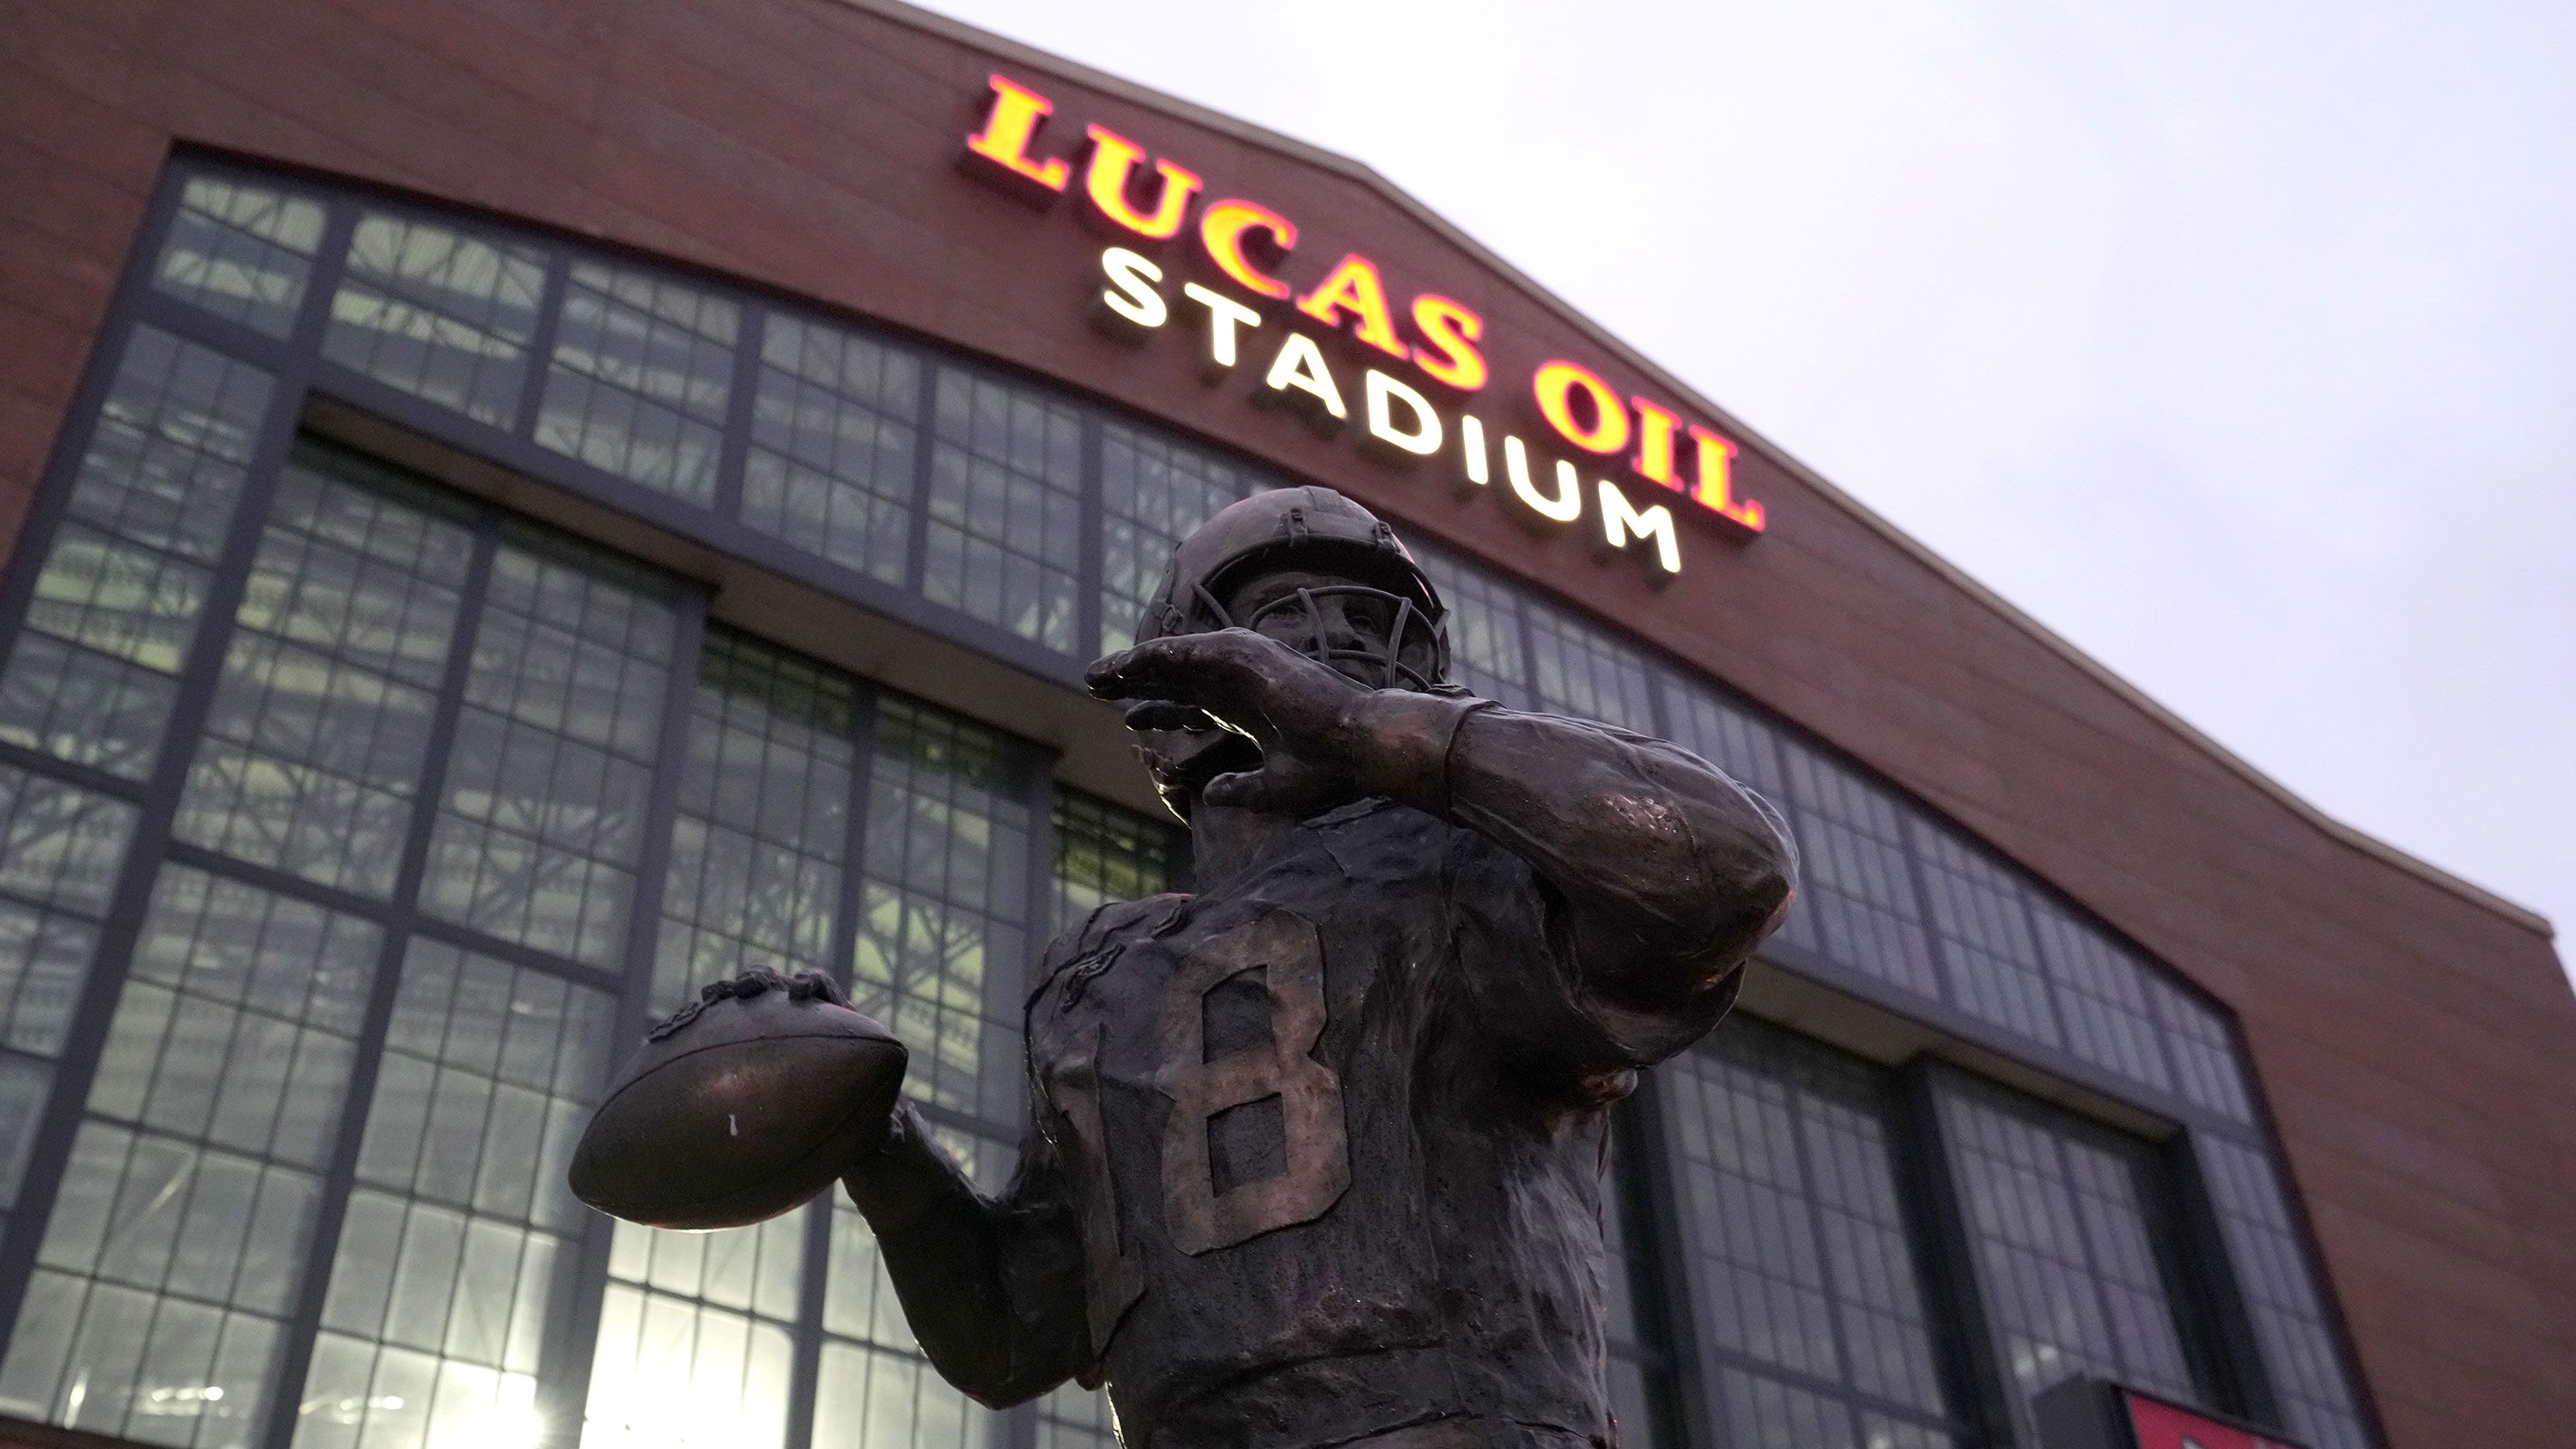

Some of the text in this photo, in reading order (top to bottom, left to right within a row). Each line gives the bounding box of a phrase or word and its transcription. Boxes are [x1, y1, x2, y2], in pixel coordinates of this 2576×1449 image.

[967, 74, 1766, 532] LUCAS OIL
[1101, 246, 1683, 574] STADIUM
